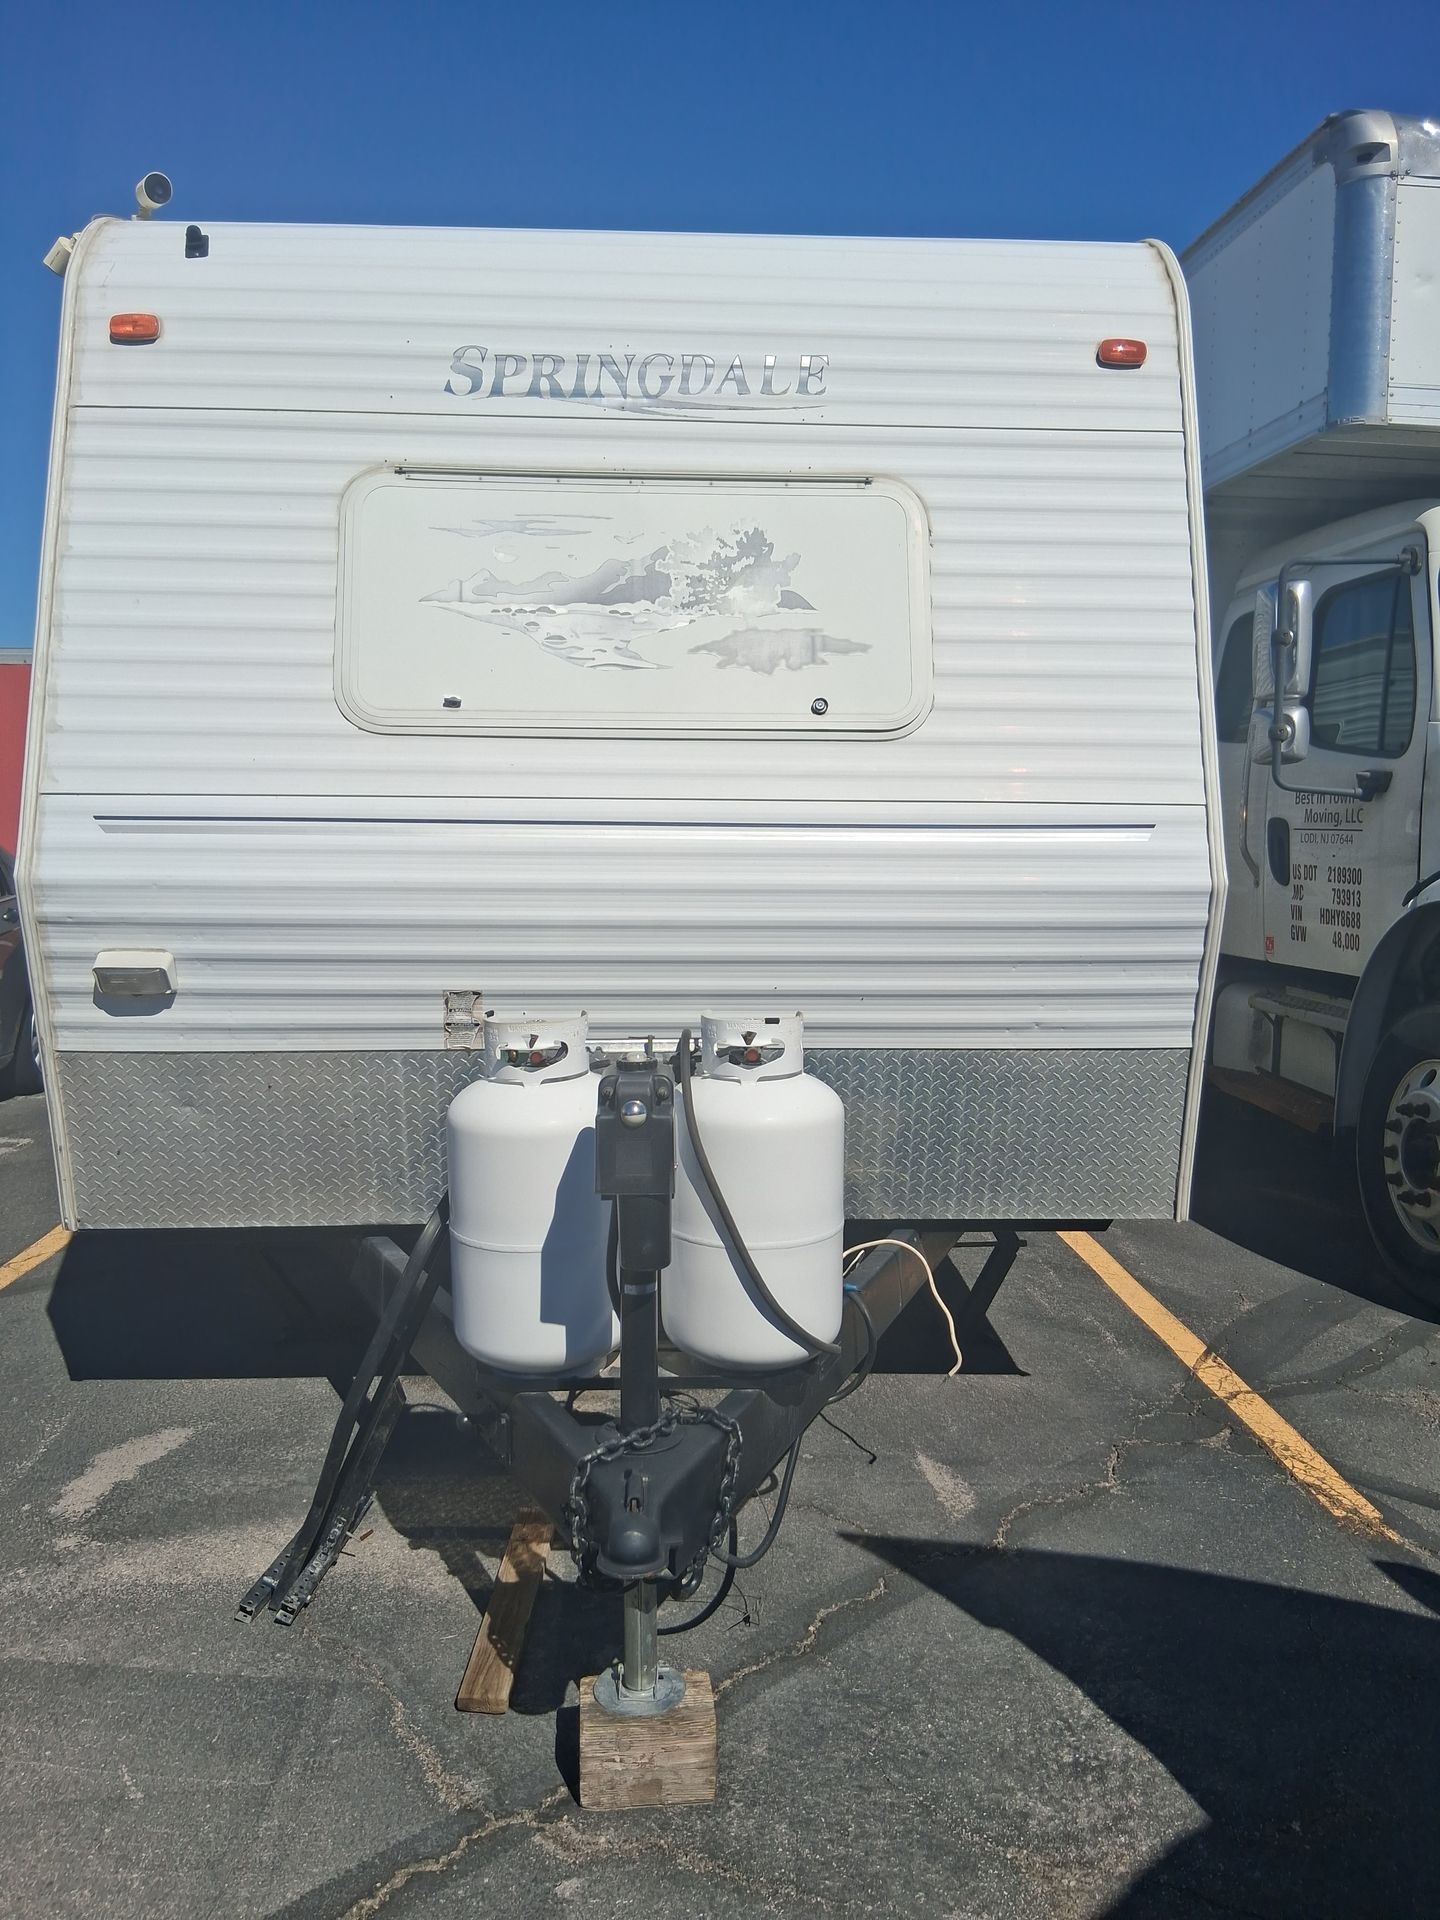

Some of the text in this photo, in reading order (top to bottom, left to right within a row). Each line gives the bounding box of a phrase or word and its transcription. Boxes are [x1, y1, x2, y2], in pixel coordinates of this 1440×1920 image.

[443, 345, 830, 399] SPRINGDALE
[1295, 791, 1314, 805] Best
[1304, 808, 1364, 827] Moving, LLC
[1300, 833, 1354, 845] LODI, NJ 07644
[1292, 864, 1362, 886] US DOT 2189300
[1292, 884, 1361, 908] MC 793913
[1290, 904, 1361, 930] VIN HDHY8688
[1290, 924, 1360, 952] GVW 48,000
